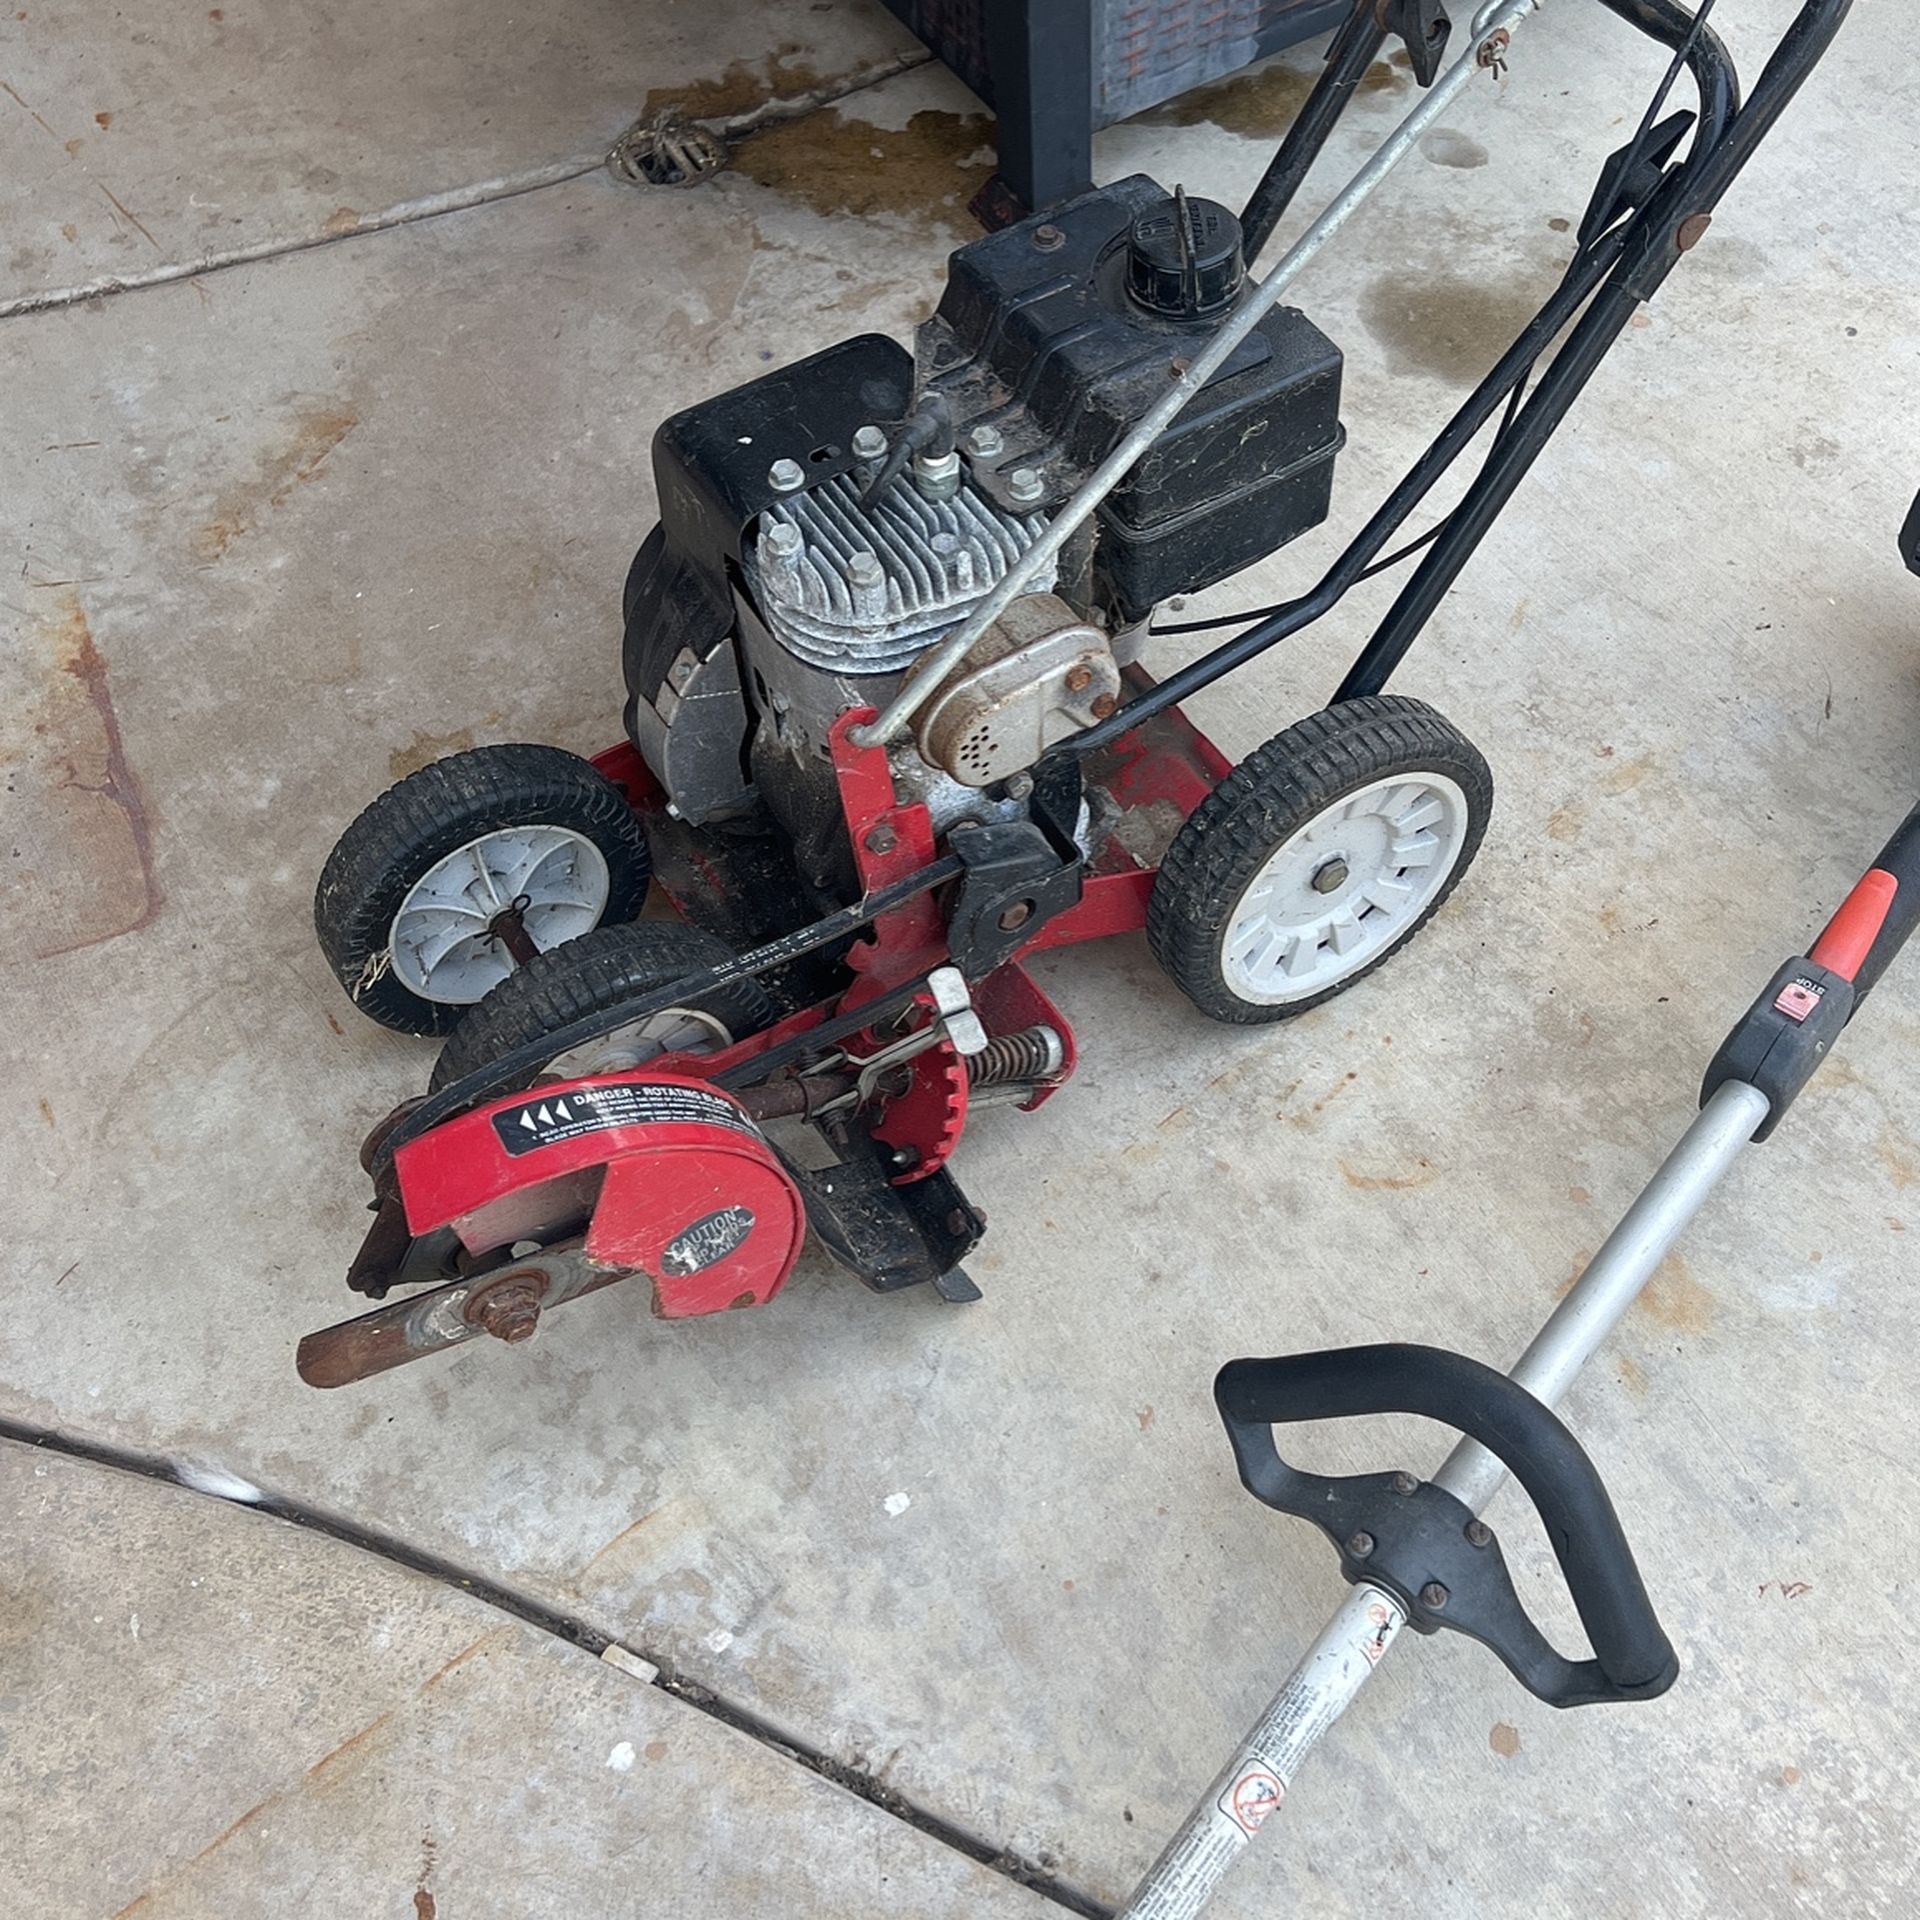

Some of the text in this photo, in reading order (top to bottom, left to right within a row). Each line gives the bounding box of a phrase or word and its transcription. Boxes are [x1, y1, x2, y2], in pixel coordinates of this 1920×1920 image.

[1796, 977, 1826, 995] STOP
[573, 1087, 633, 1106] DANGER
[642, 1087, 701, 1100] ROTATING
[670, 1208, 737, 1255] CAUTION
